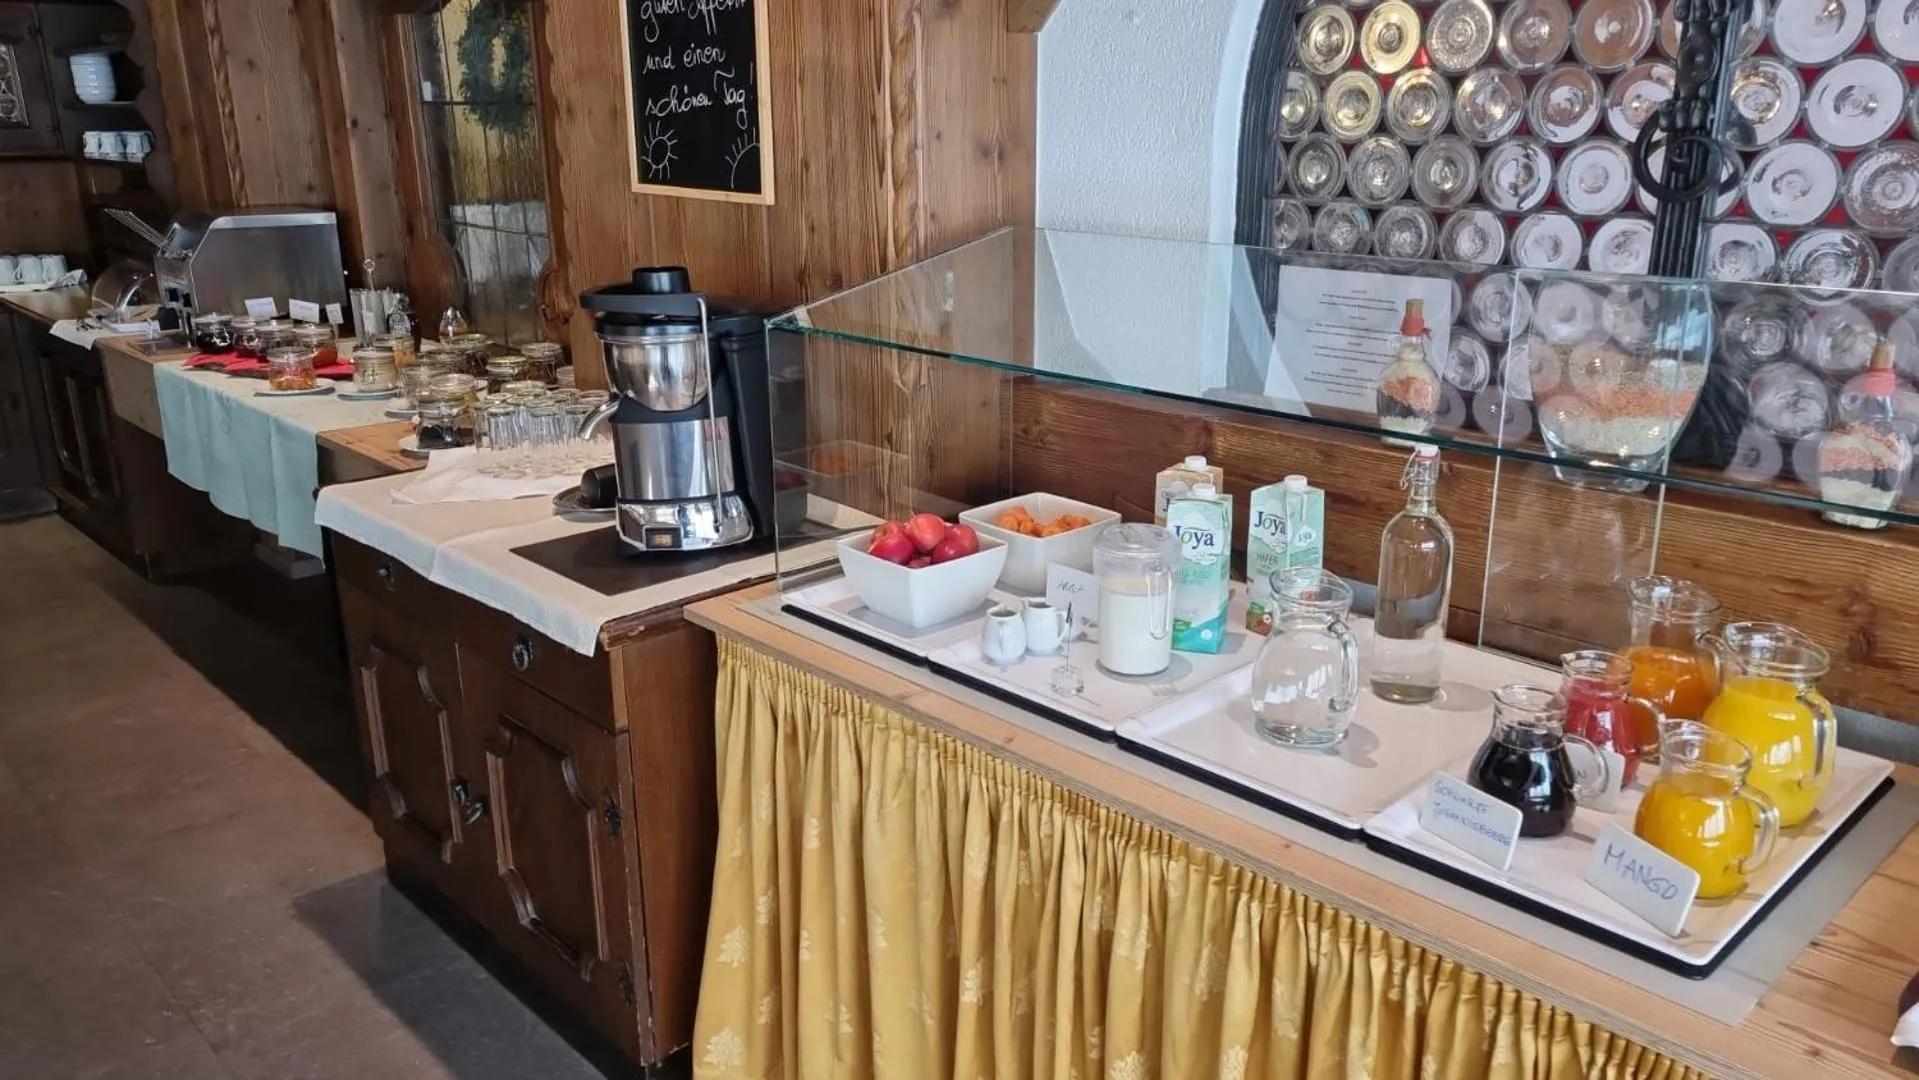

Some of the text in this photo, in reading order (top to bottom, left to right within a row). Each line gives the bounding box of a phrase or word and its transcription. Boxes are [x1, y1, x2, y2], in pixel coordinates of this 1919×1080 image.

[642, 42, 726, 75] und einen
[1173, 525, 1215, 550] Joya
[1253, 511, 1286, 536] Joya
[1603, 841, 1679, 900] MANGO
